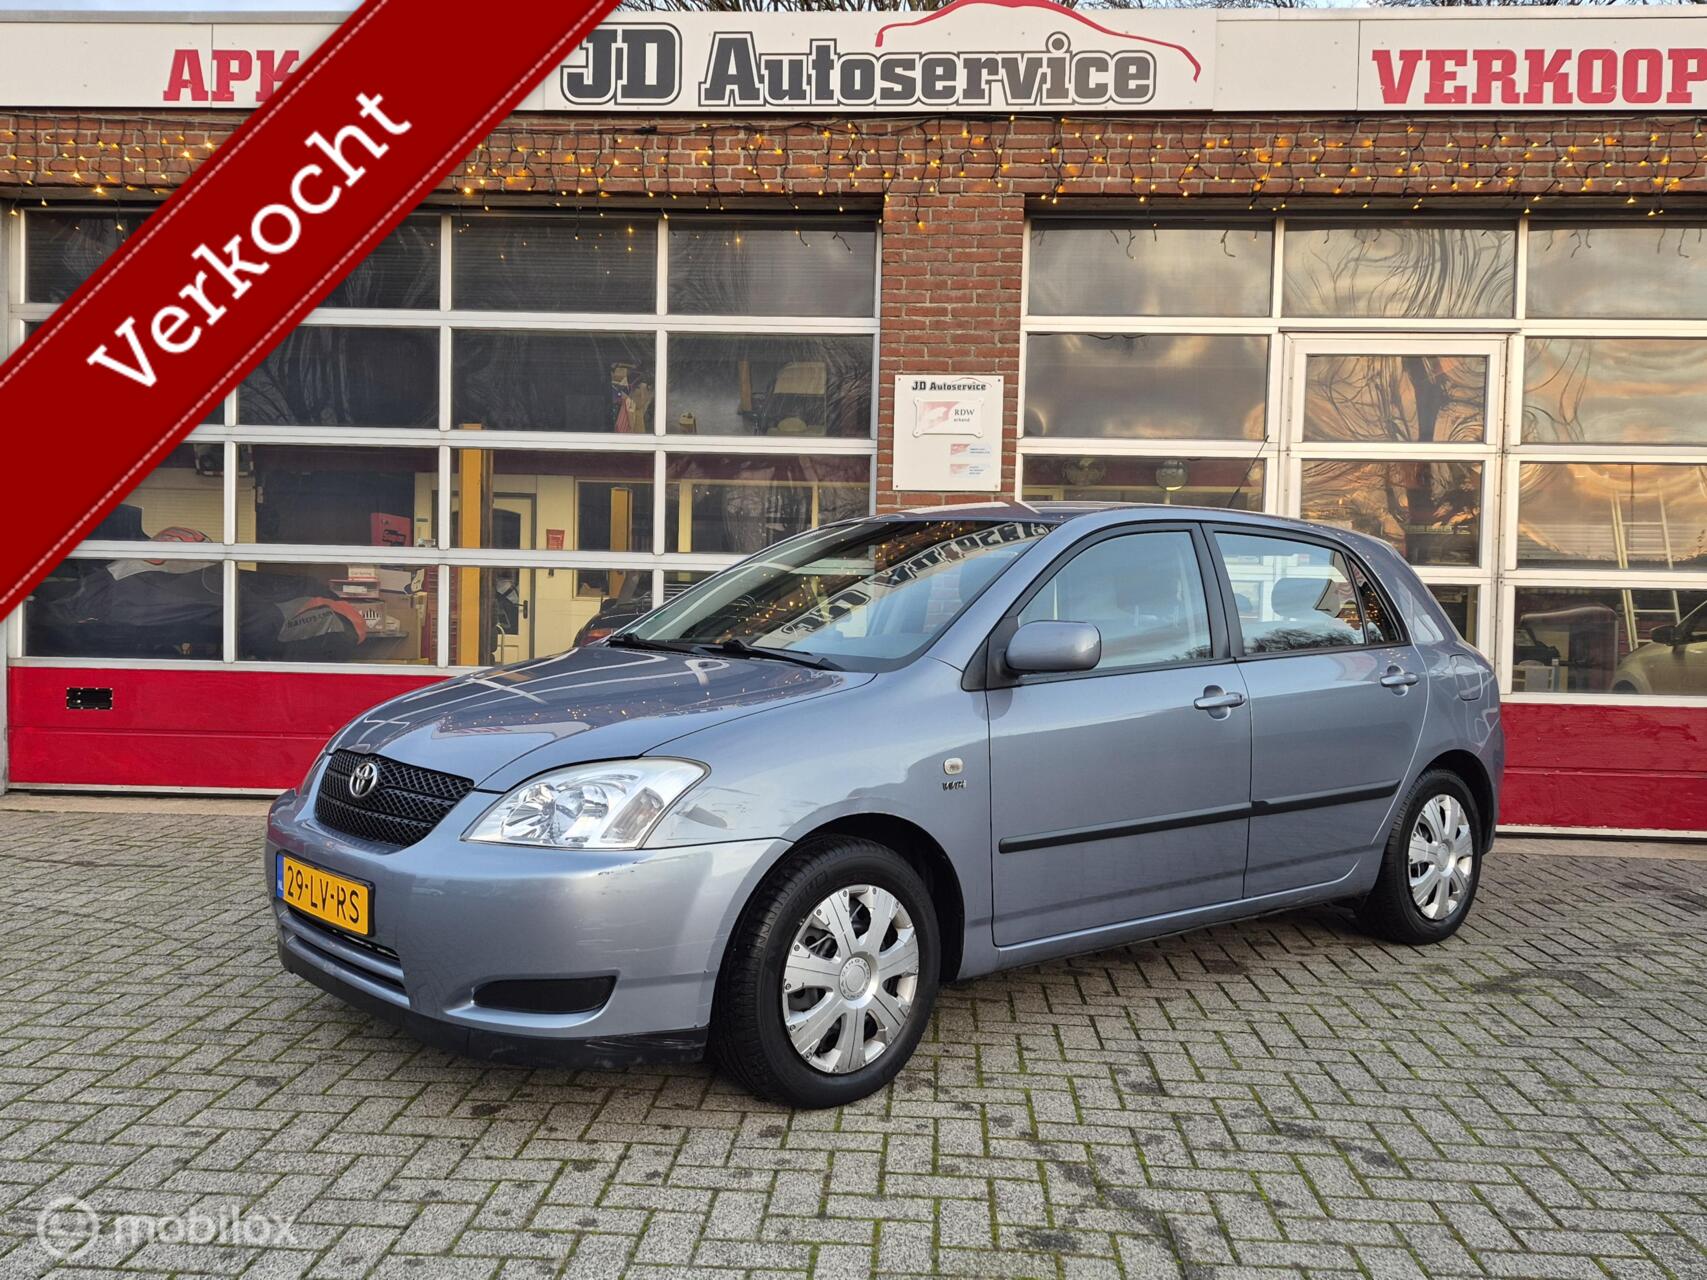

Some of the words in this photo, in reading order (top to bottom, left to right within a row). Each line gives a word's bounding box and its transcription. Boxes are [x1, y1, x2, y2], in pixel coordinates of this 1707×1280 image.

[163, 49, 299, 102] APK
[560, 22, 682, 105] JD
[698, 31, 1156, 106] Autoservice
[1372, 48, 1707, 104] VERKOOP
[912, 381, 926, 390] JD
[929, 382, 987, 390] Autoservice
[954, 408, 975, 416] RDW
[287, 865, 360, 924] 29-LV-RS
